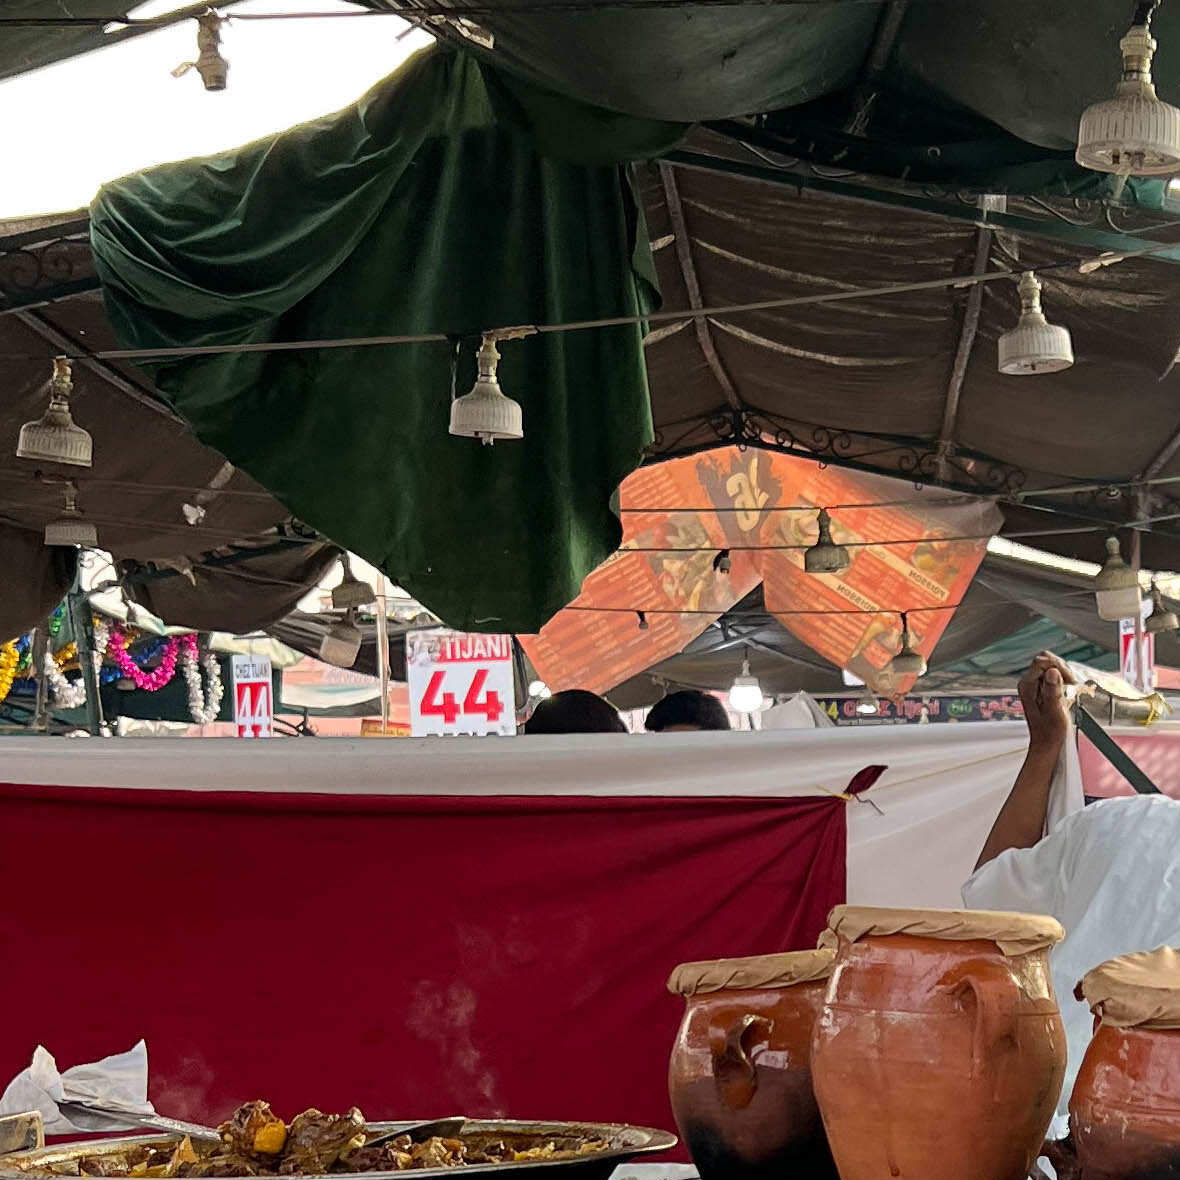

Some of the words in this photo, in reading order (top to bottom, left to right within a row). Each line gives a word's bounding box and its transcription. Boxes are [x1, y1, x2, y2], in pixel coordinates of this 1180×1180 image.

[445, 634, 509, 660] TIJANI
[238, 685, 271, 737] 44
[420, 669, 504, 724] 44
